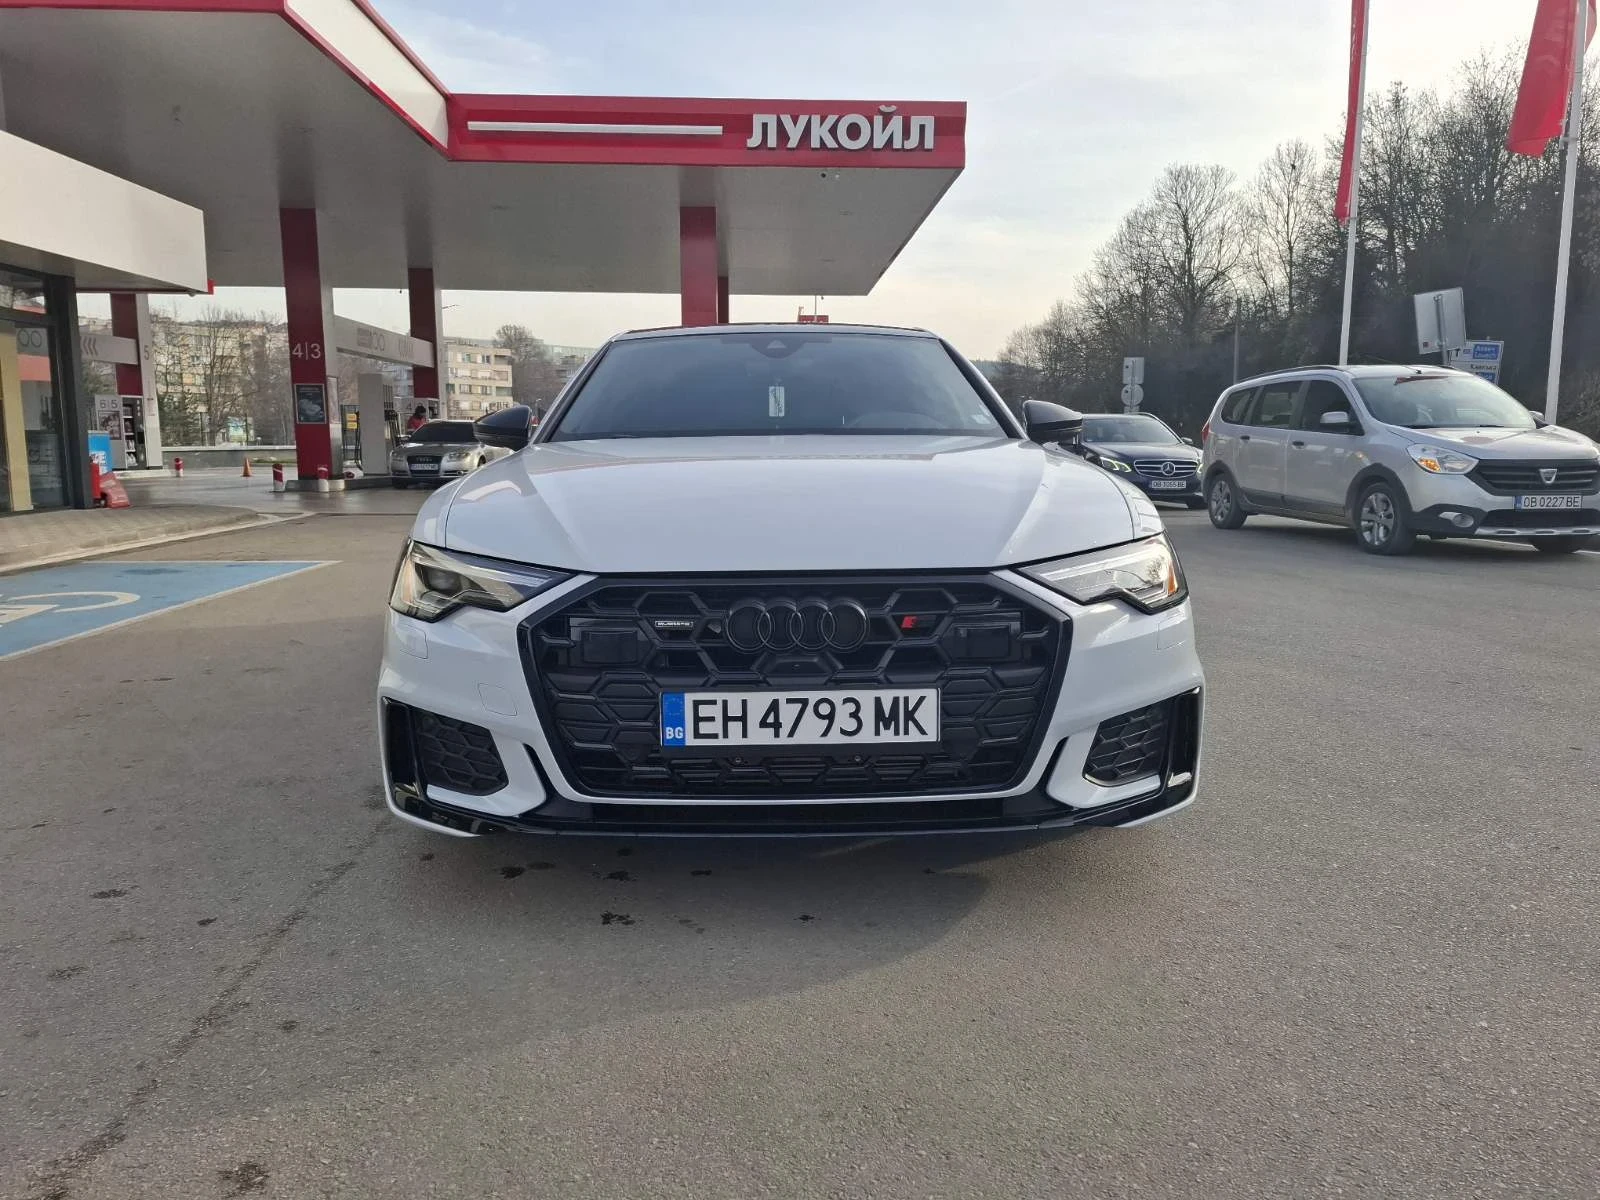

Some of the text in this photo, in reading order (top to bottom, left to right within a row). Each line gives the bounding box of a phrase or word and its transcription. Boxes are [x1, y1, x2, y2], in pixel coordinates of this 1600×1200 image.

[747, 105, 934, 150] ЛУКОЙЛ
[1523, 496, 1537, 508] OB
[1539, 496, 1564, 508] 0227
[1566, 496, 1580, 508] BE
[665, 695, 929, 739] BG EH 4793 MK
